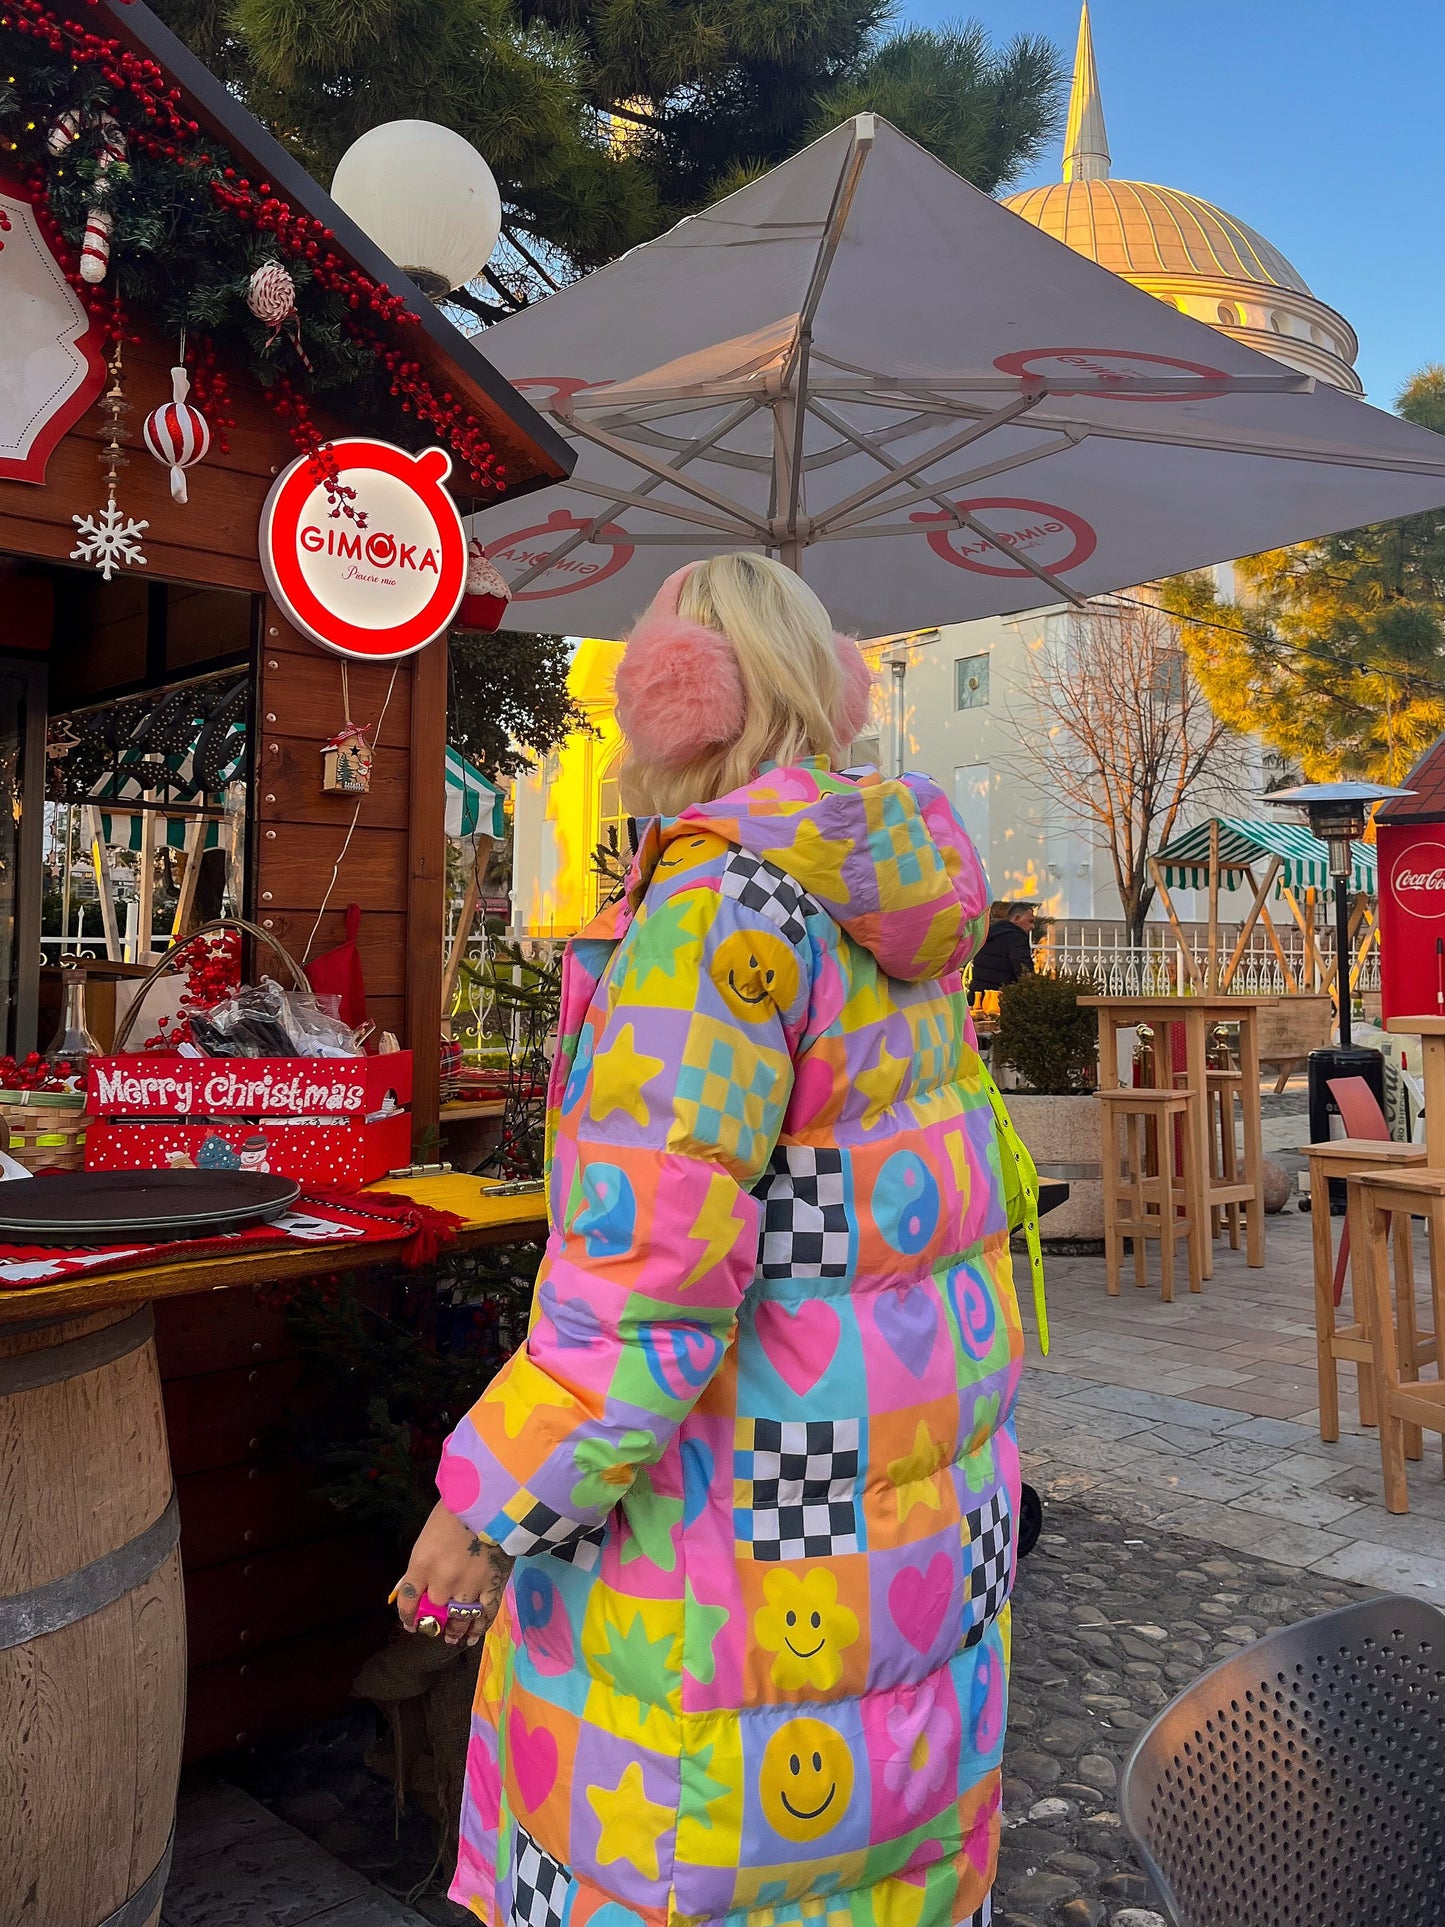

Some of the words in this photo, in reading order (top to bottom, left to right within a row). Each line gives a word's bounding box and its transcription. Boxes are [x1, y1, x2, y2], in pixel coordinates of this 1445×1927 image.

[300, 525, 439, 574] GIMOKA
[341, 565, 379, 583] Piacere
[381, 577, 397, 586] mio
[1395, 868, 1445, 891] Coca-Co
[96, 1069, 193, 1113] Merry
[203, 1072, 365, 1111] Christmas
